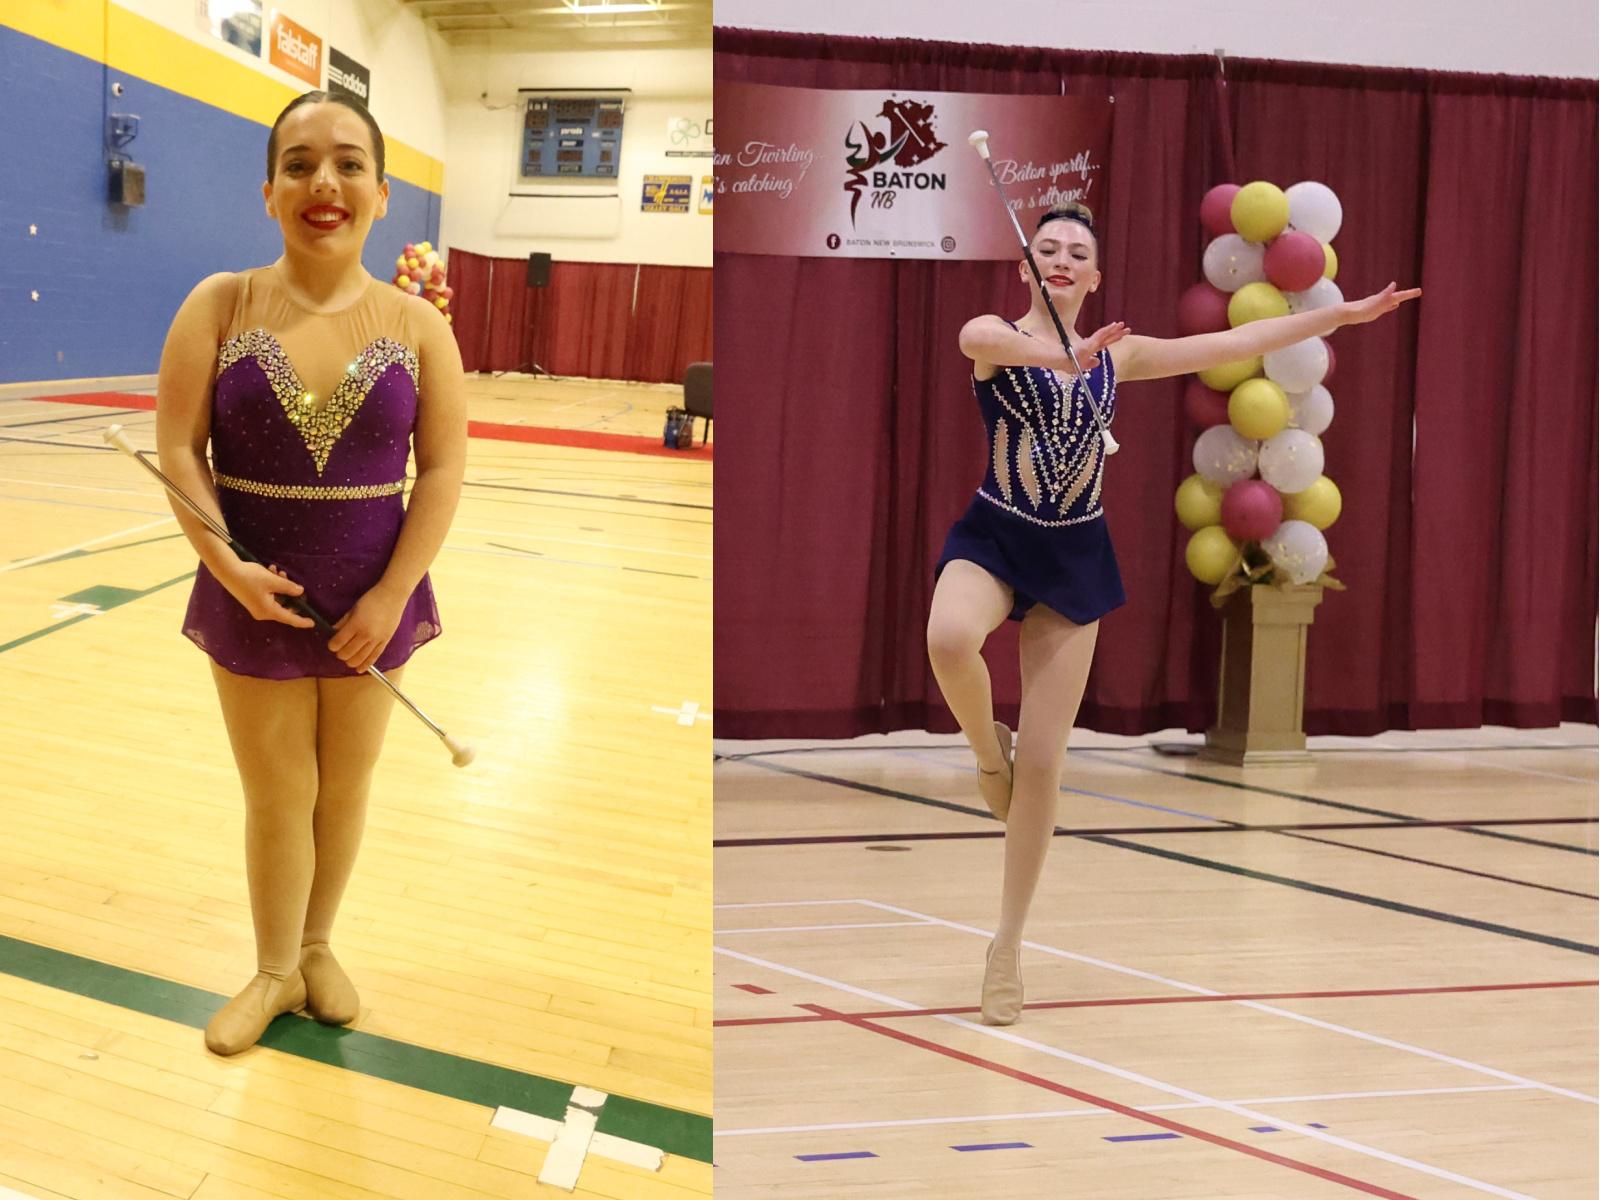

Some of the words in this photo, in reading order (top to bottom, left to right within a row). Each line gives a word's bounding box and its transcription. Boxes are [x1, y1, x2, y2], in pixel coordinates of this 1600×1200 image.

[276, 23, 318, 70] falstaff
[342, 73, 367, 99] adidas
[713, 152, 732, 166] on
[732, 170, 806, 199] catching!
[873, 171, 946, 190] BATON
[870, 190, 896, 209] NB
[893, 240, 936, 248] BRUNSWICK
